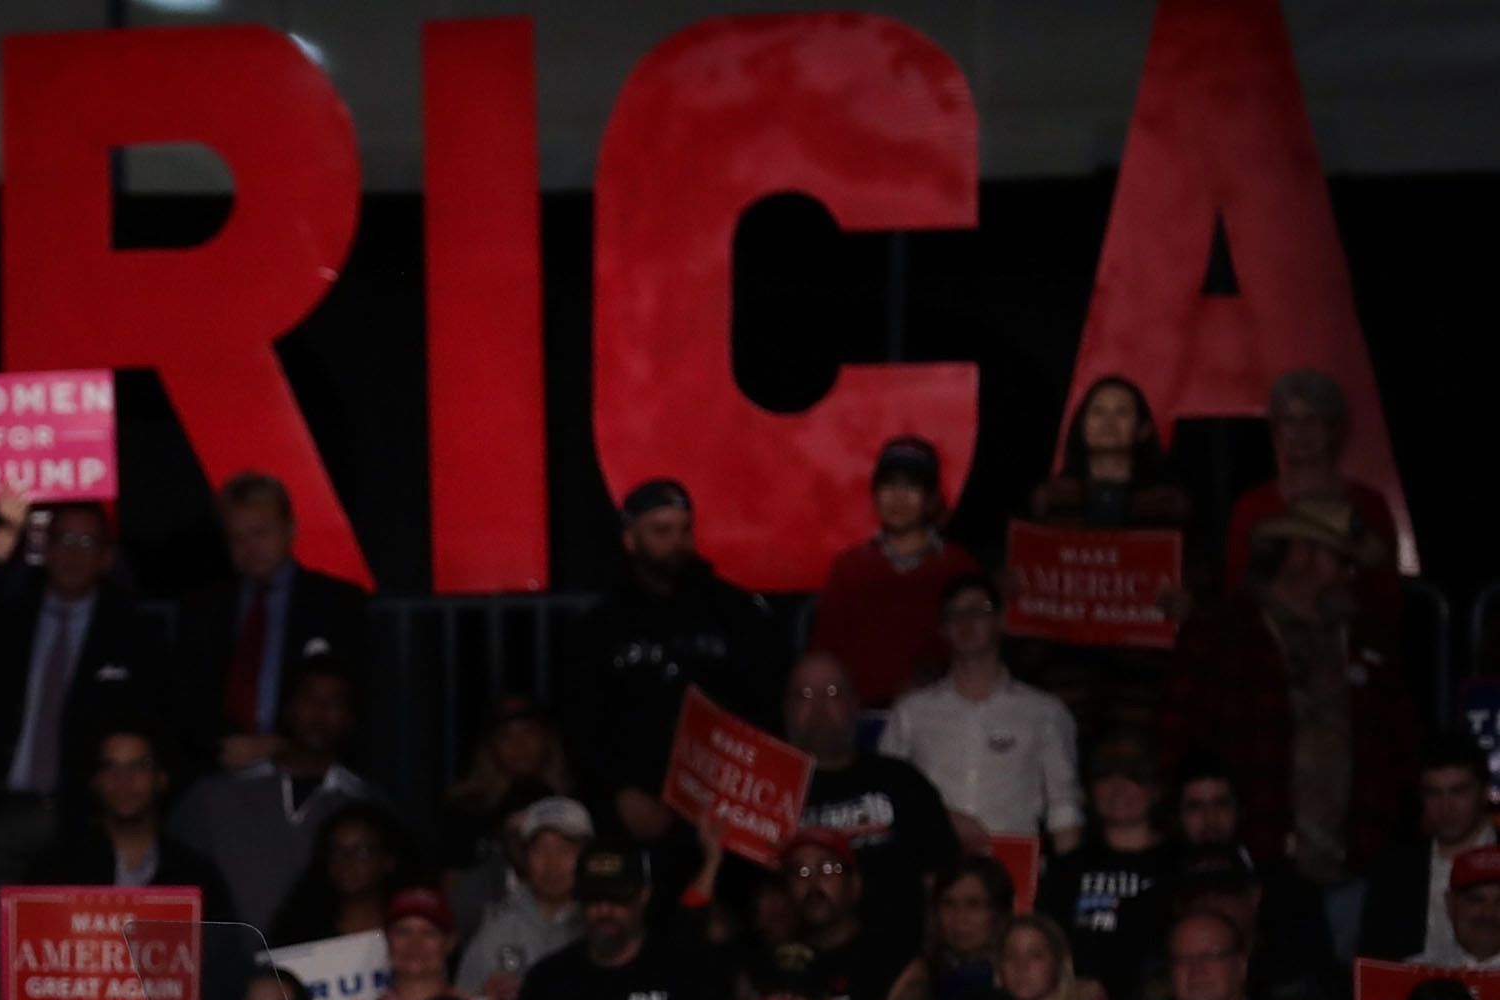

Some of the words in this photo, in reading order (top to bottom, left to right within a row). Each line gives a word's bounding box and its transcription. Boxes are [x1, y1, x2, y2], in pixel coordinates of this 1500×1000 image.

[70, 911, 138, 934] MAKE
[15, 938, 198, 973] AMERICA
[24, 976, 99, 1000] GREAT
